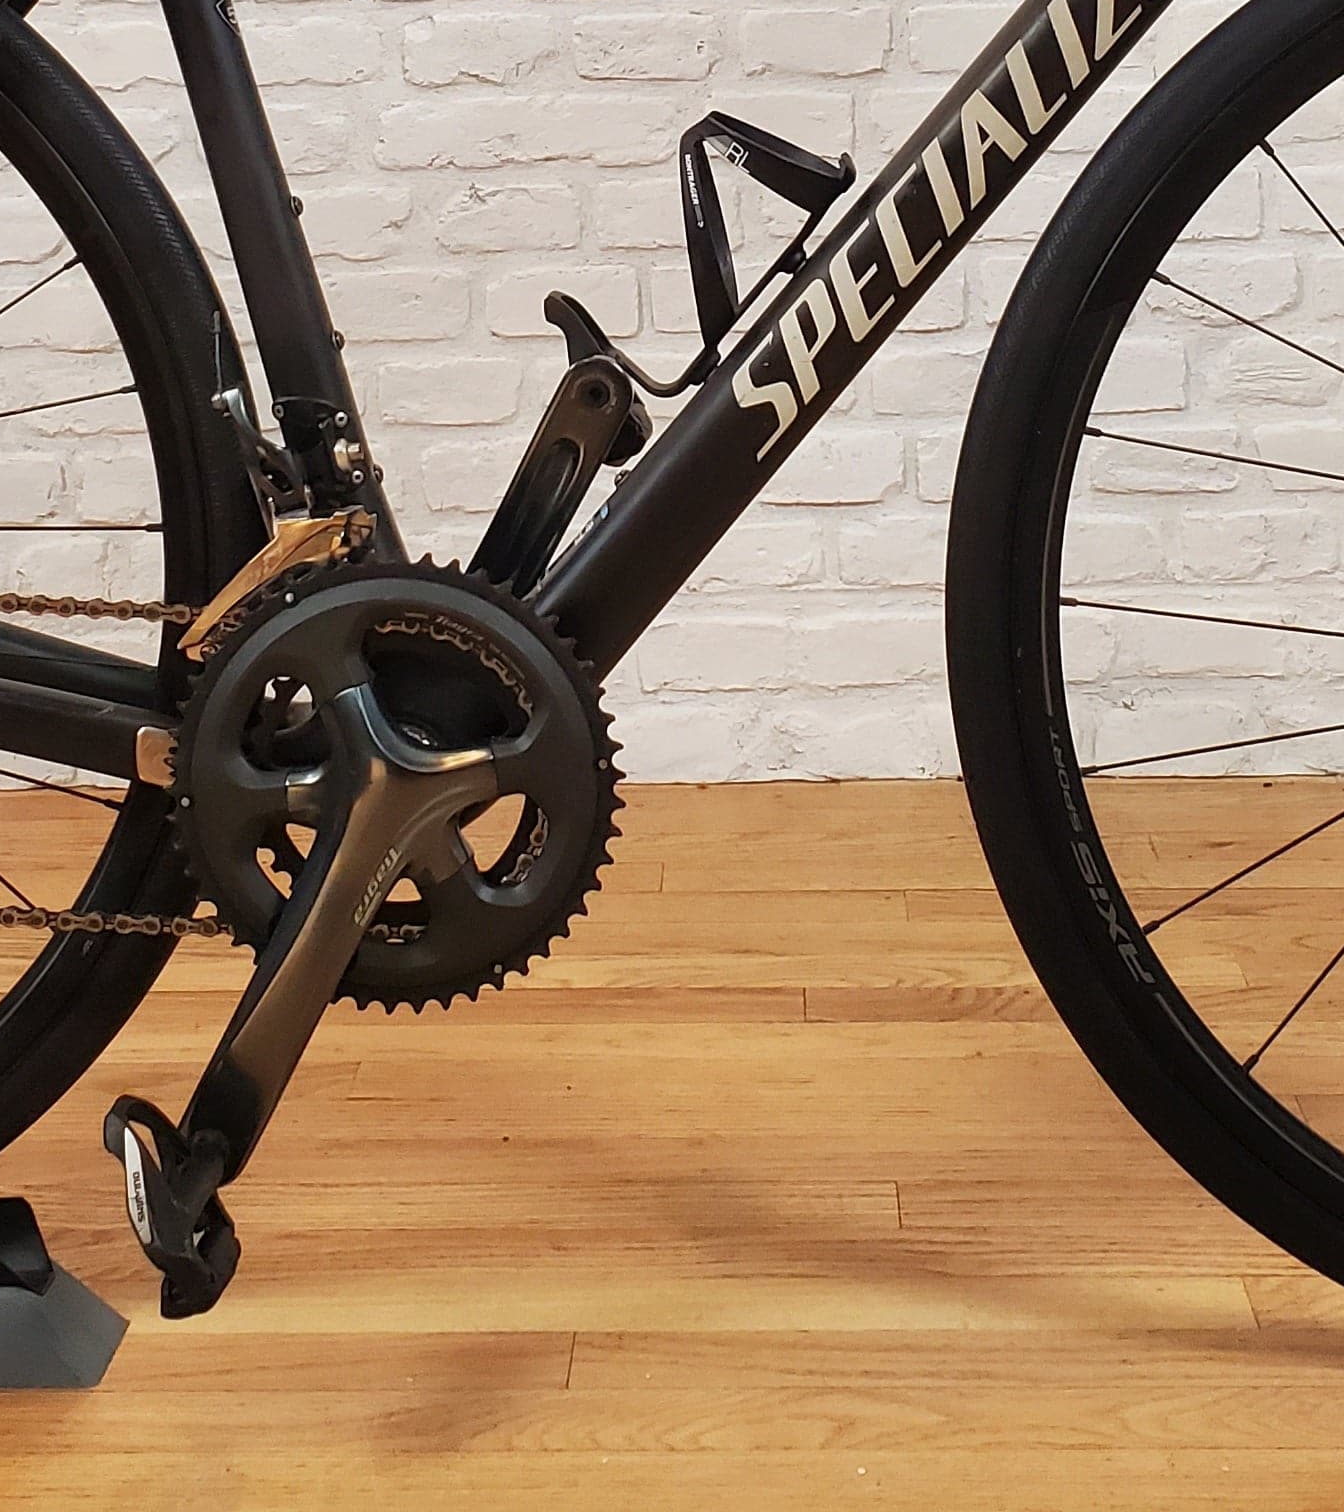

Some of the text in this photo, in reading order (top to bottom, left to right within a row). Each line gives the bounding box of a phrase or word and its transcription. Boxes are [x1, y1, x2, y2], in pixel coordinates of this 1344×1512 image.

[683, 153, 700, 206] BONTRAGER
[725, 141, 753, 175] RL
[1049, 724, 1083, 833] SPORT
[354, 846, 403, 928] Tiagra
